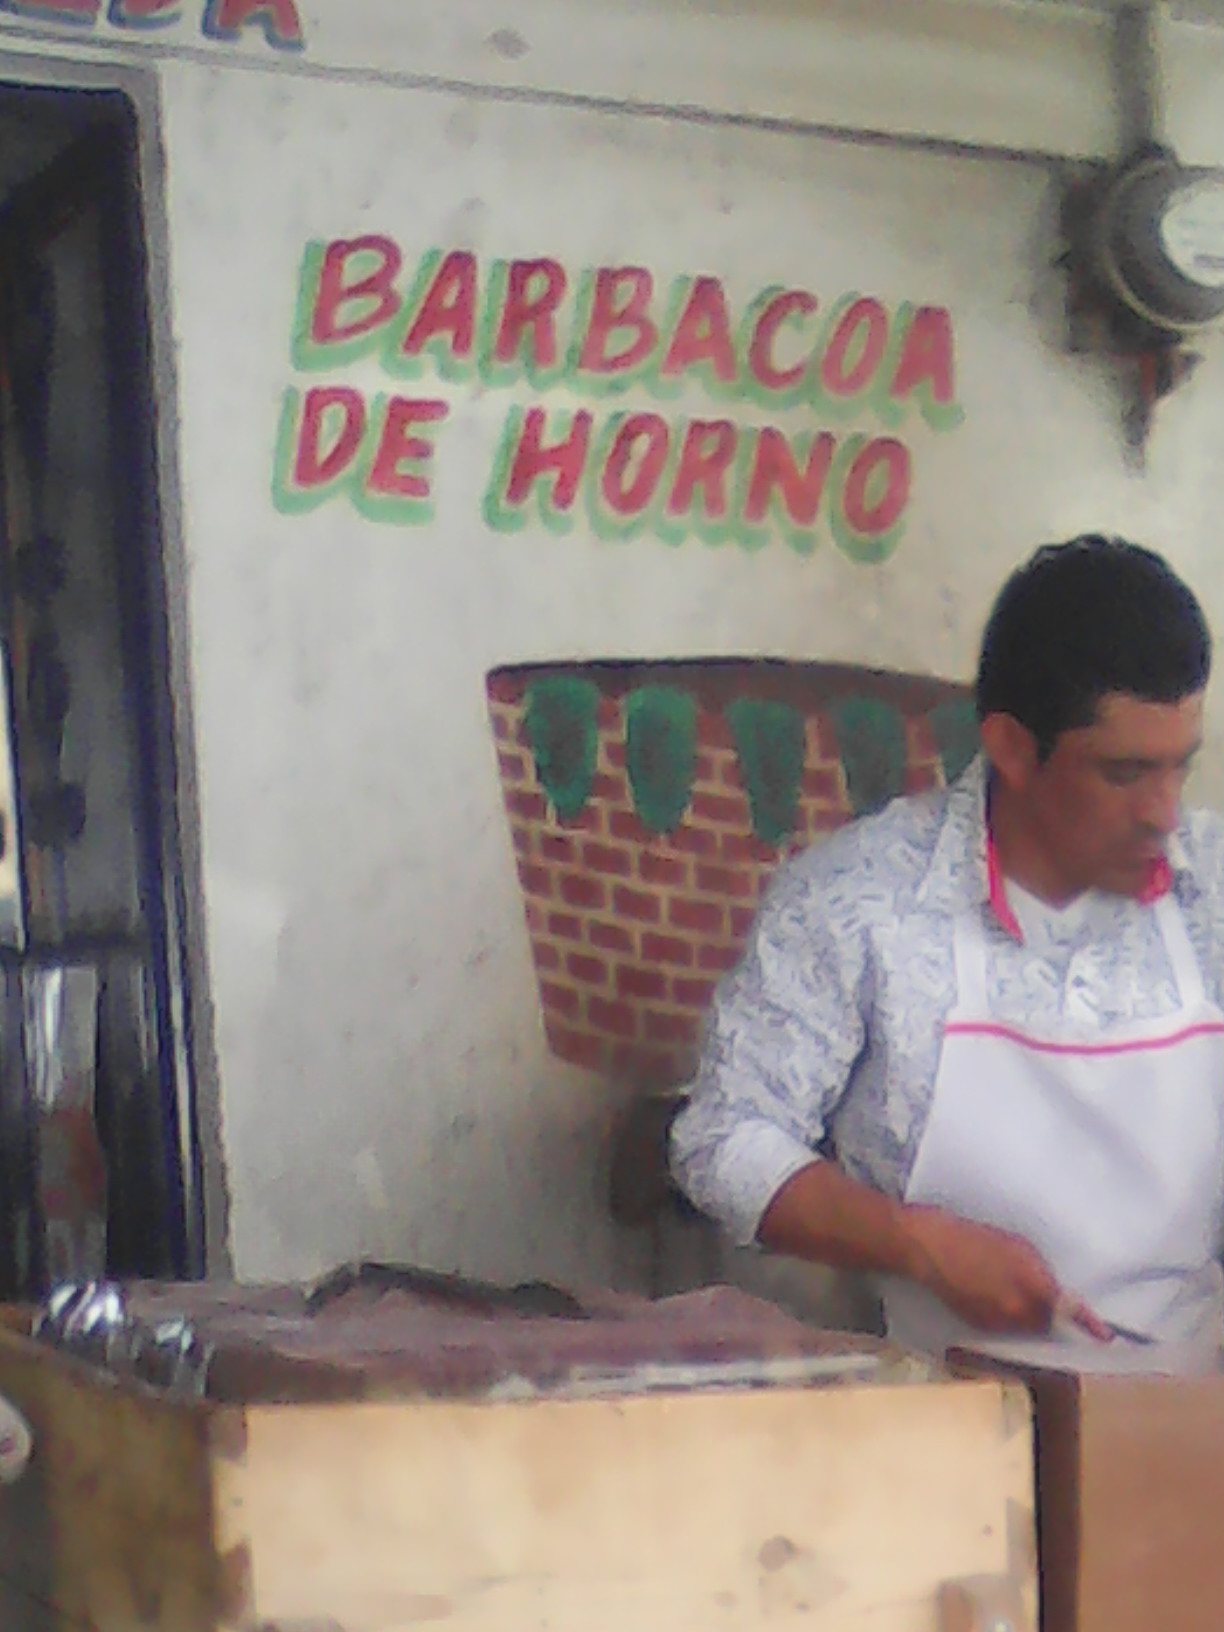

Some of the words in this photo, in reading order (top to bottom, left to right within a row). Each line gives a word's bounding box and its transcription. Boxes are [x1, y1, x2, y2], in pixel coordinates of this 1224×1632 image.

[294, 235, 960, 422] BARBACOA
[278, 385, 450, 518] DE
[488, 406, 912, 556] HORNO
